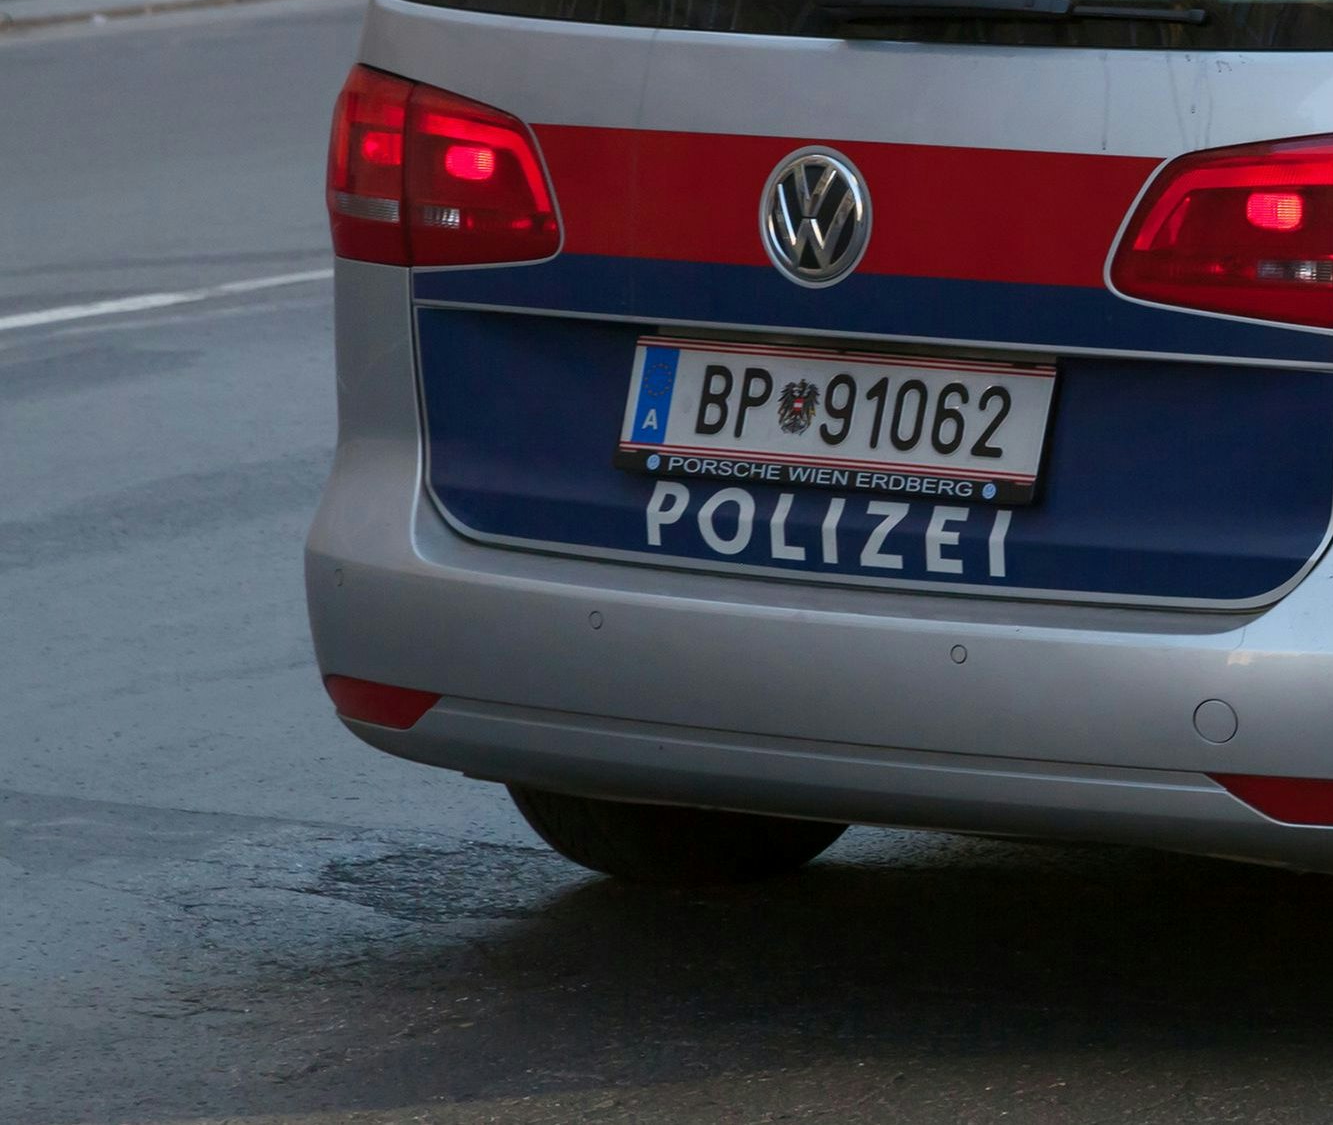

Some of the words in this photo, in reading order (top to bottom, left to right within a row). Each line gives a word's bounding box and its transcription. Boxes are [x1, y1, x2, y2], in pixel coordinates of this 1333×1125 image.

[641, 408, 659, 431] A
[695, 364, 774, 439] BP
[819, 373, 1012, 458] 91062
[667, 456, 783, 481] PORSCHE
[788, 465, 850, 487] WIEN
[855, 471, 974, 498] ERDBERG
[645, 480, 1013, 578] POLIZEI
